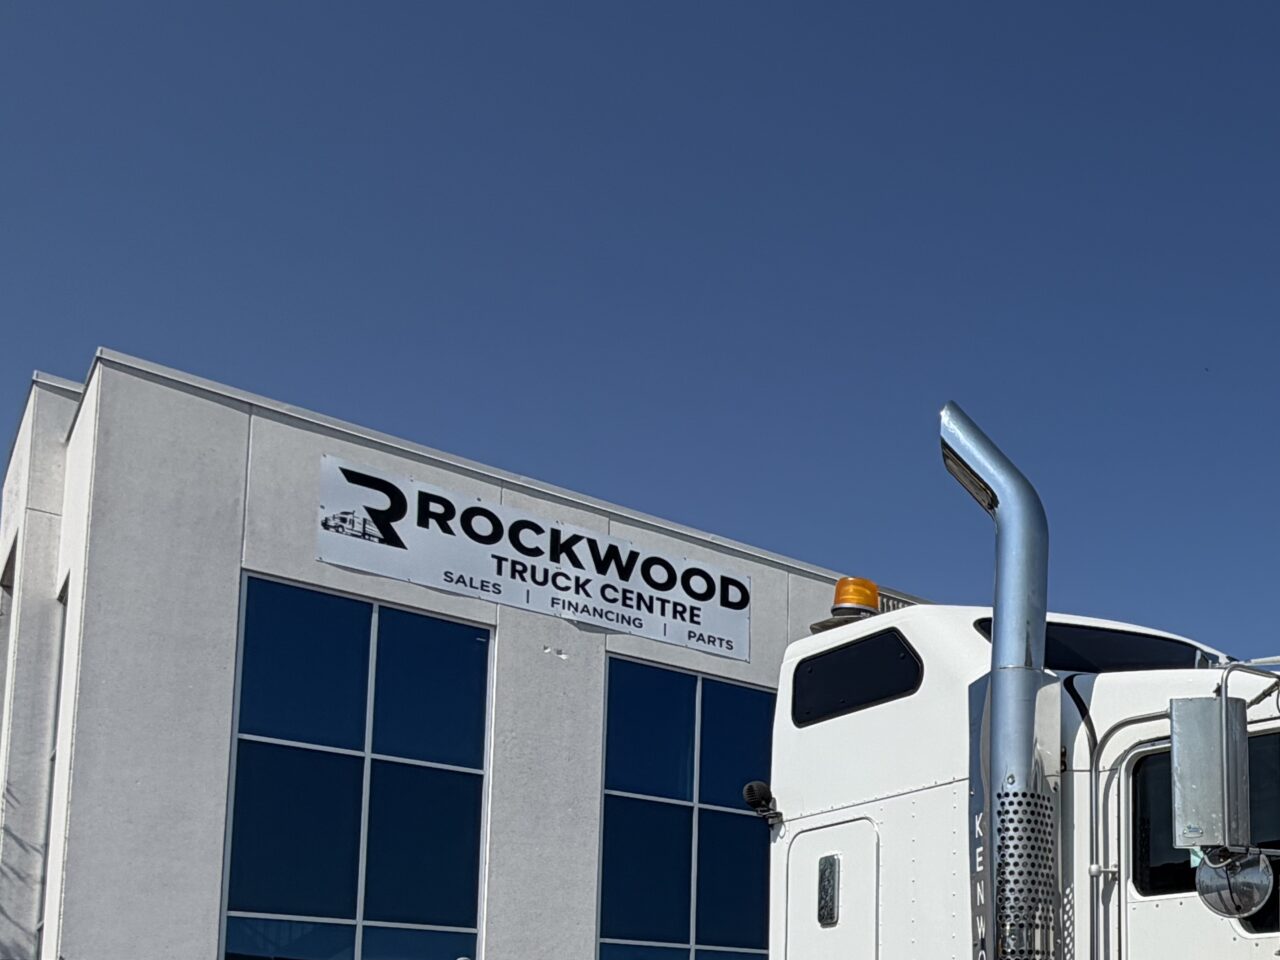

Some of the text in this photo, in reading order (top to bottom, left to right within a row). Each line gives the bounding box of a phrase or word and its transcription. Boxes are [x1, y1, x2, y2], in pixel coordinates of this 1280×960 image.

[416, 490, 750, 611] ROCKWOOD
[491, 554, 702, 625] TRUCK CENTRE
[443, 570, 734, 651] SALES FINANCING PARTS
